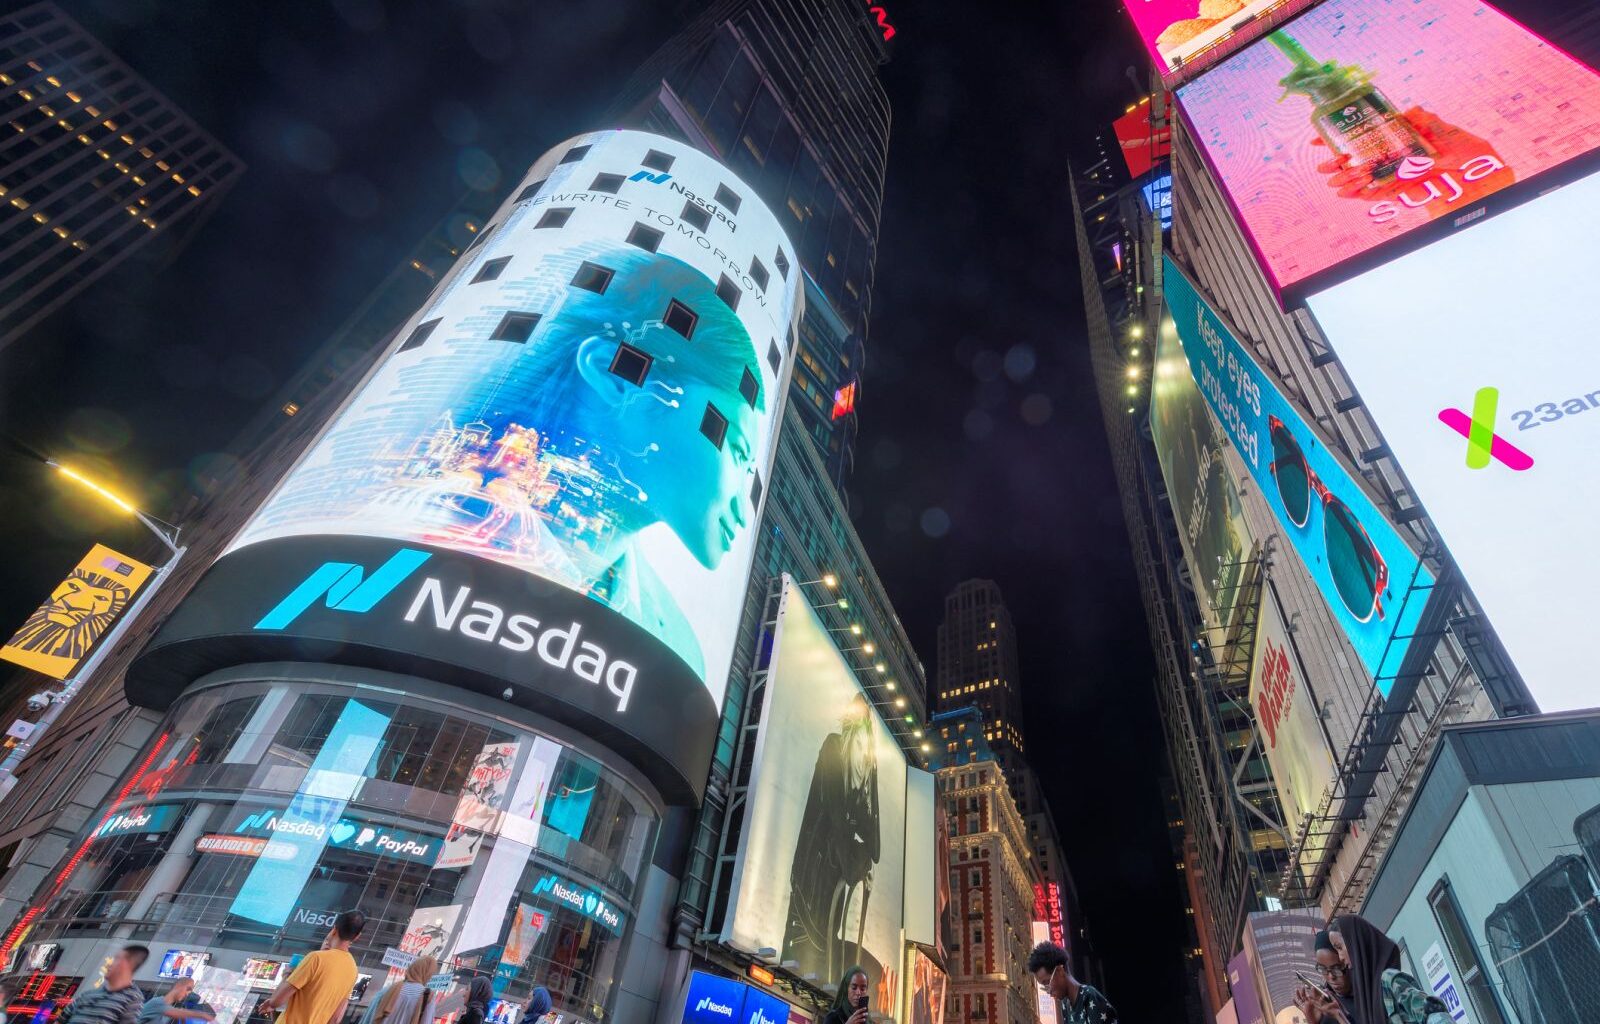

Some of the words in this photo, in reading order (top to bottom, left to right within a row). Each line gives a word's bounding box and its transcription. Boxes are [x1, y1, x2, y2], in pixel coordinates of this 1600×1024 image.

[670, 181, 737, 233] Nasdaq
[1368, 154, 1506, 224] suja
[519, 193, 632, 210] REWRITE
[644, 207, 767, 308] TOMORROW
[1196, 301, 1225, 369] Keep
[1227, 351, 1262, 418] eyes
[1200, 359, 1259, 469] protected
[1188, 487, 1203, 546] SINCE
[1197, 444, 1212, 498] 1960
[404, 577, 638, 713] Nasdaq
[118, 814, 152, 830] PayPal
[266, 817, 327, 841] Nasdaq
[376, 835, 429, 856] PayPal
[198, 837, 253, 853] BRANDED
[293, 908, 339, 928] Nasd
[552, 883, 585, 910] Nasdaq
[602, 908, 619, 927] PayPal
[1048, 883, 1060, 923] Locker
[1051, 926, 1063, 948] oot
[708, 1001, 732, 1018] Nasdaq
[1439, 983, 1460, 1013] YPD
